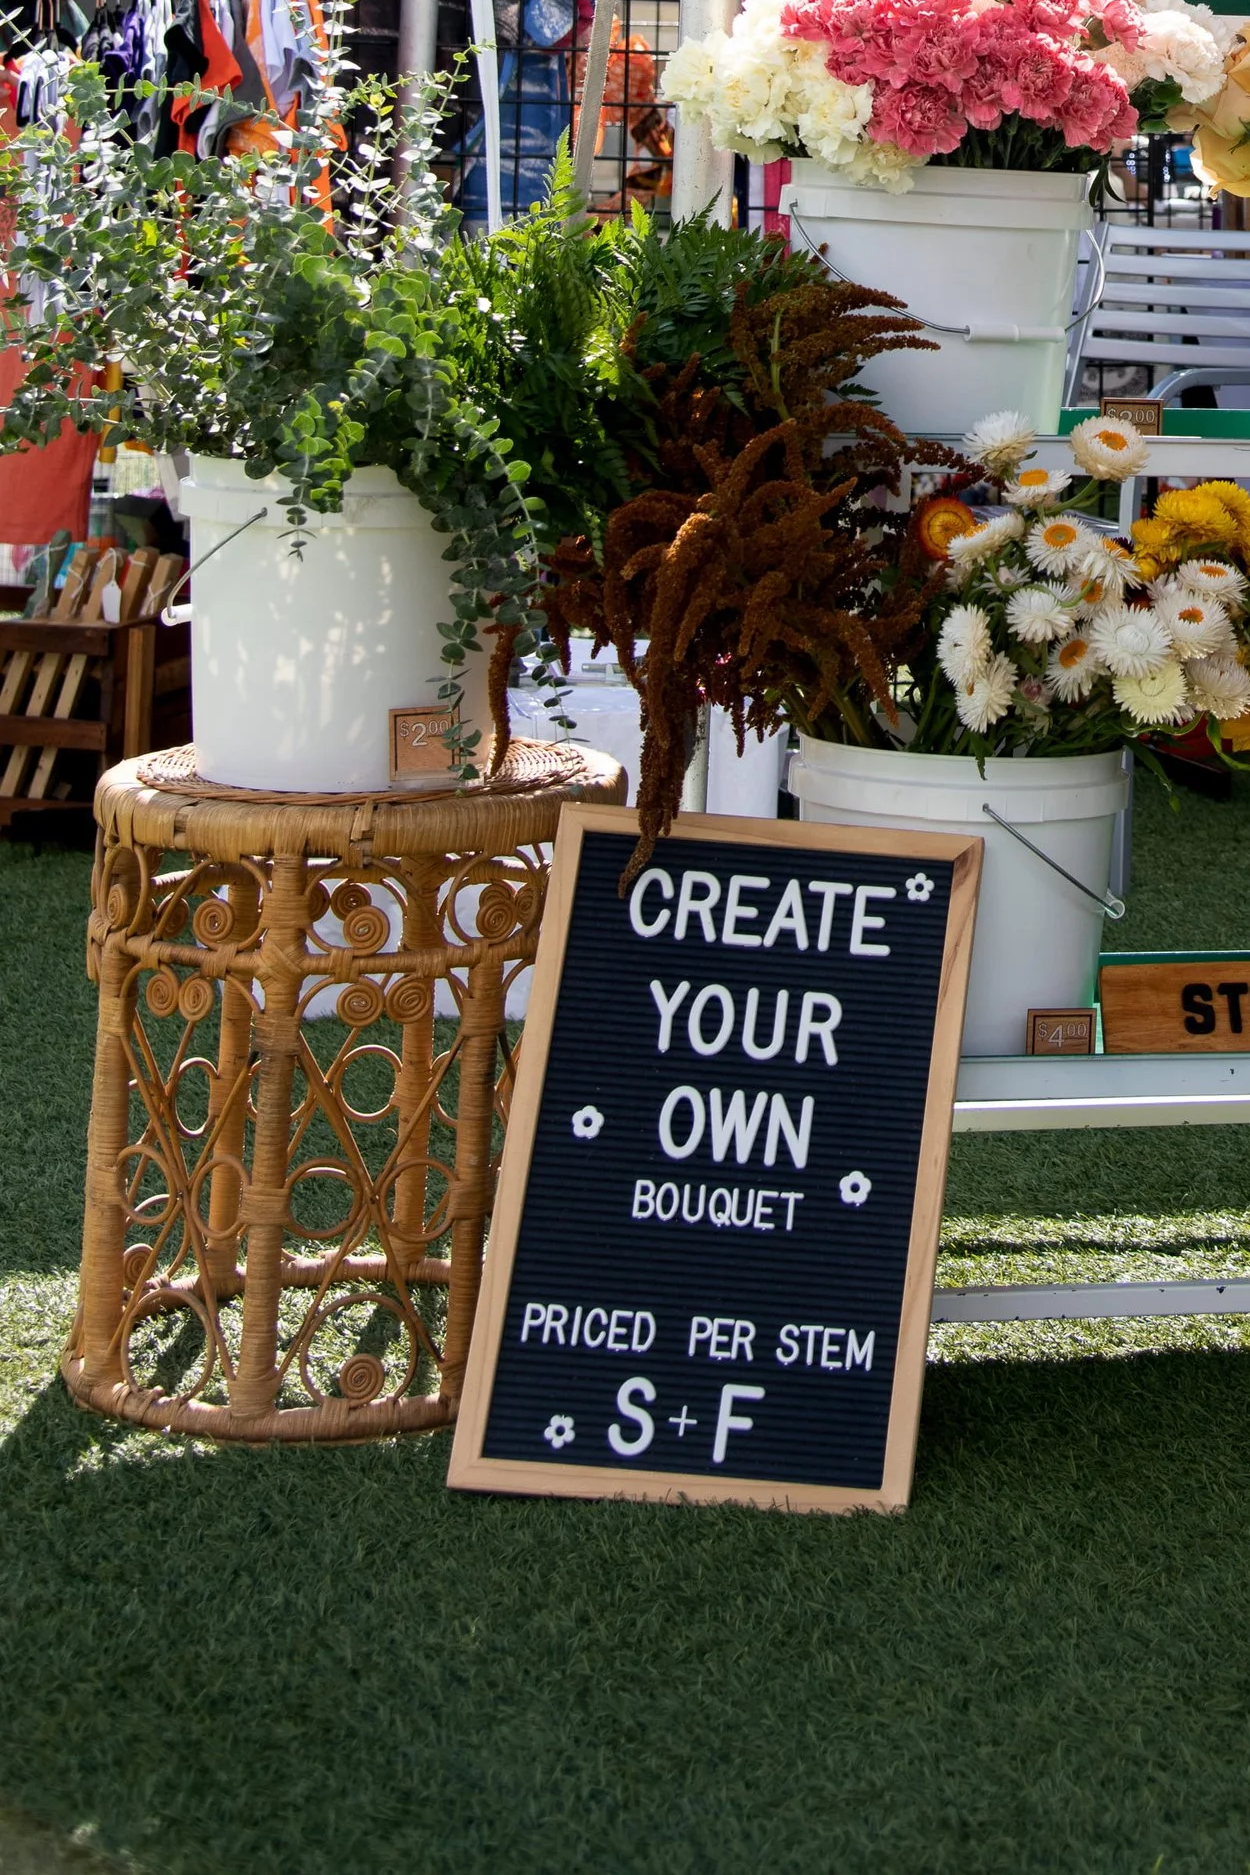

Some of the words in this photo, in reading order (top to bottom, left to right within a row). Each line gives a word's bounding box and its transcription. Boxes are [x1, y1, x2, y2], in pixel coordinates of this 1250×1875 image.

[630, 869, 897, 955] CREATE
[651, 979, 841, 1065] YOUR
[659, 1086, 813, 1168] OWN
[633, 1180, 804, 1231] BOUQUET
[521, 1303, 655, 1353] PRICED
[689, 1316, 755, 1361] PER
[777, 1325, 875, 1371] STEM
